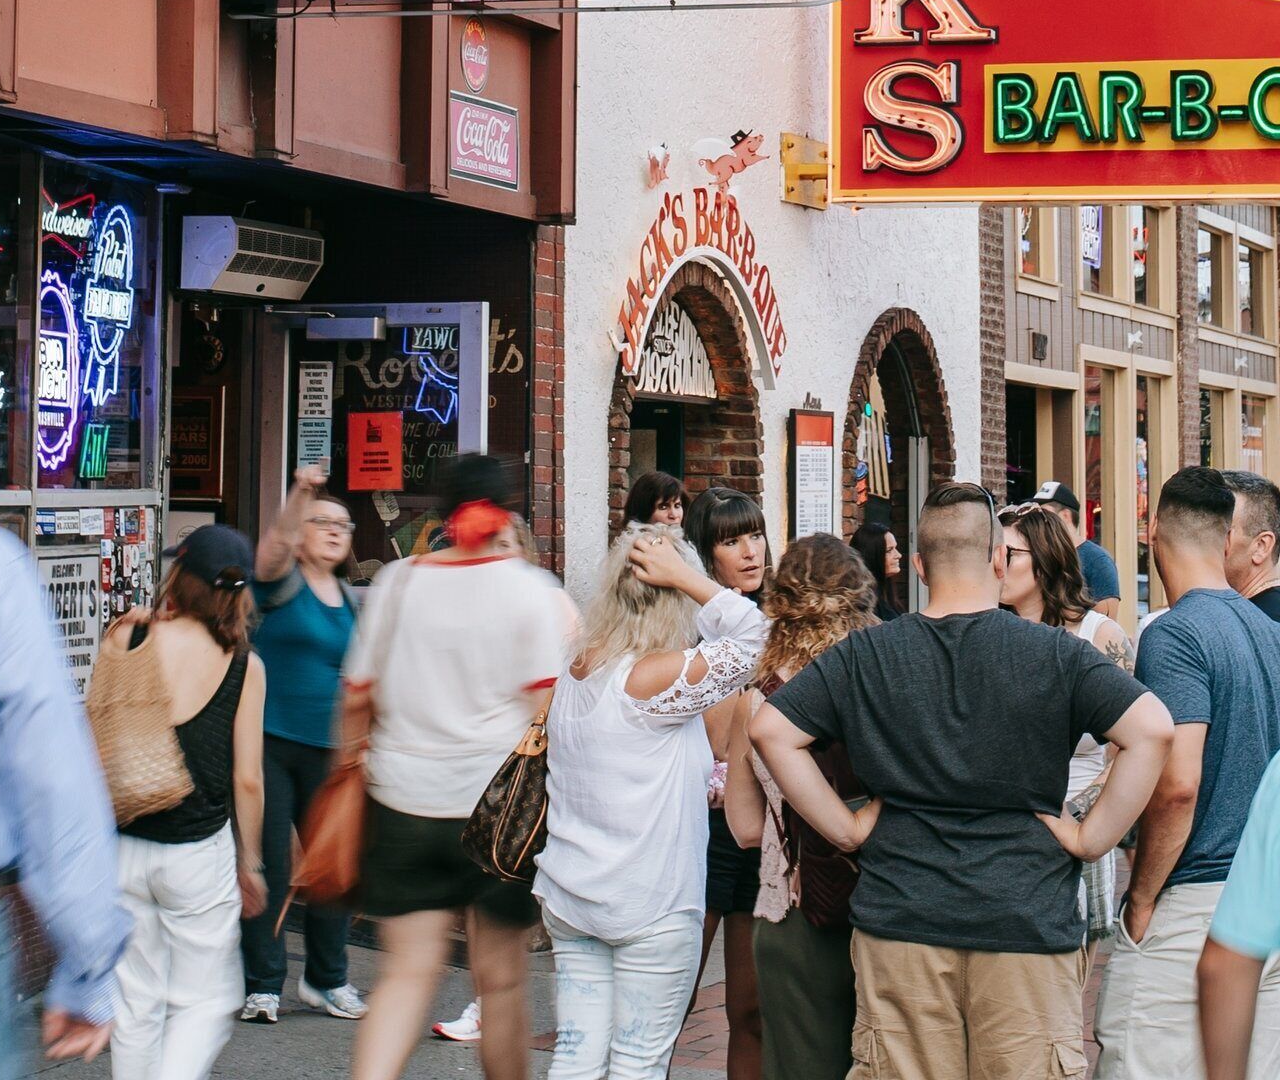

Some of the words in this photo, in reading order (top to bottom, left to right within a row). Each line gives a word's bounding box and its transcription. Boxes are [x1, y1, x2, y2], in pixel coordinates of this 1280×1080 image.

[457, 107, 511, 165] Coca-Cola
[618, 191, 688, 372] JACK'S
[51, 564, 76, 579] WELCOME
[68, 638, 94, 649] TRADITION
